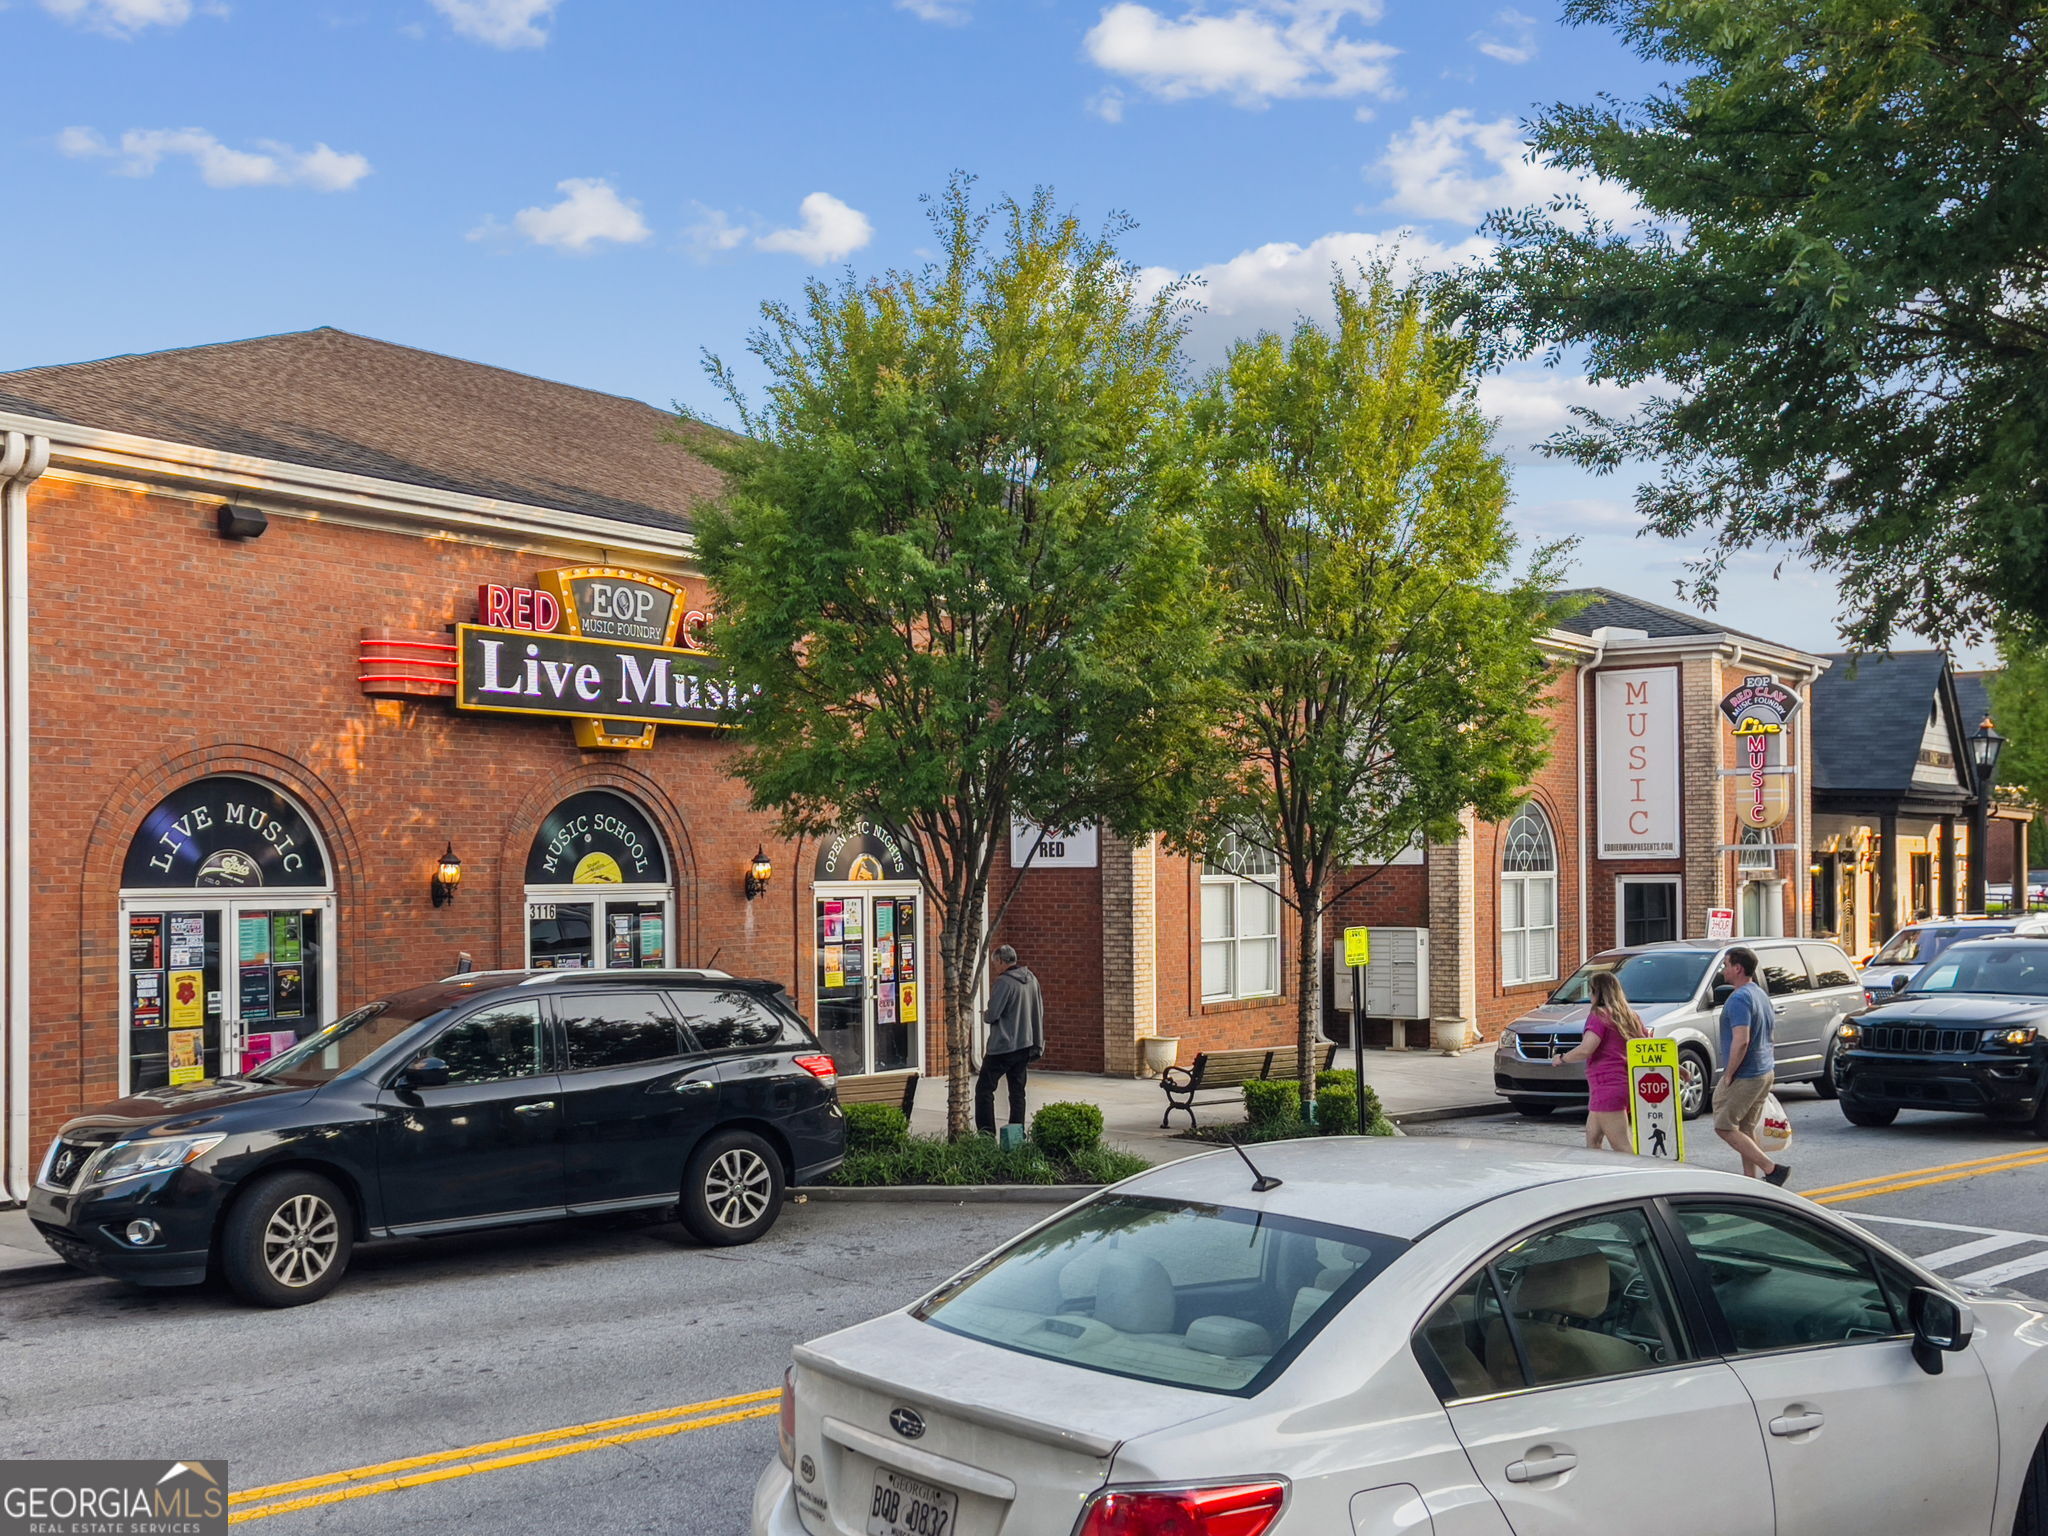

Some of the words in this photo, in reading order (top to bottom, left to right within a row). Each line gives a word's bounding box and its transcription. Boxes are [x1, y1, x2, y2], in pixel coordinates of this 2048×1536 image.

[488, 584, 559, 632] RED
[591, 583, 654, 622] EOP
[582, 618, 614, 634] MUSIC
[617, 622, 662, 640] FOUNDRY
[477, 638, 601, 701] Live
[1746, 676, 1770, 688] EOP
[1730, 688, 1753, 707] RED
[1755, 687, 1787, 702] CLAY
[1732, 698, 1754, 717] MUSIC
[1754, 697, 1786, 715] FOUNDRY
[1731, 717, 1782, 735] Live
[1625, 681, 1648, 835] MUSIC
[1748, 735, 1766, 822] MUSIC
[150, 805, 213, 873] LIVE
[224, 803, 303, 873] MUSIC
[542, 815, 588, 874] MUSIC
[593, 814, 648, 874] SCHOOL
[825, 834, 847, 873] OPEN
[873, 824, 904, 873] NIGHTS
[1039, 841, 1065, 857] RED
[529, 904, 555, 919] 3116
[1636, 1043, 1667, 1053] STATE
[1641, 1055, 1662, 1063] LAW
[1640, 1082, 1668, 1094] STOP
[892, 1476, 936, 1503] GEORGIA
[872, 1485, 900, 1524] BQB
